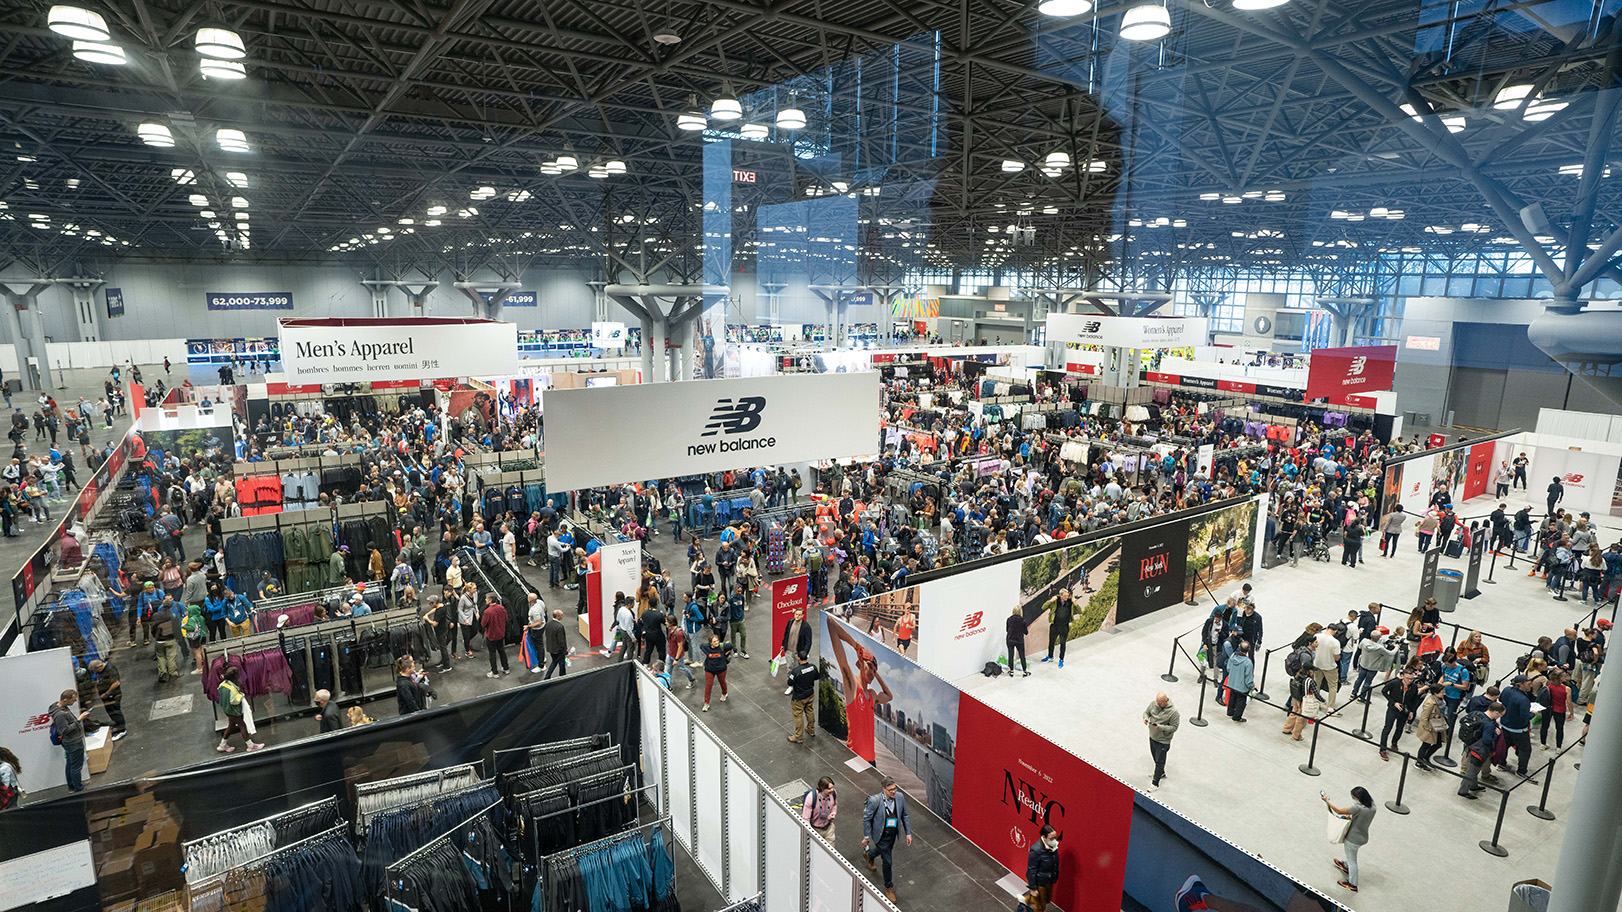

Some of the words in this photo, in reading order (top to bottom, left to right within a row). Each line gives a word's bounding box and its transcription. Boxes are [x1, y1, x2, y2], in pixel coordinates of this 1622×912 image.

[212, 297, 288, 307] 62,000-73,999
[296, 340, 346, 359] Men's
[350, 337, 414, 361] Apparel
[297, 366, 329, 375] hombres
[333, 364, 363, 373] hommes
[367, 363, 390, 371] herren
[394, 362, 418, 370] uomini
[421, 360, 440, 369] 男性
[1346, 356, 1367, 376] NB
[1351, 377, 1367, 385] balance
[700, 396, 767, 437] NB
[687, 443, 717, 456] new
[719, 437, 776, 453] balance
[1139, 552, 1170, 581] RUN
[776, 598, 803, 609] Checkout
[959, 610, 983, 632] NB
[965, 627, 987, 638] balance
[1018, 758, 1037, 774] November
[1042, 773, 1054, 785] 2022
[1001, 768, 1065, 841] NYC
[1018, 788, 1047, 819] Ready
